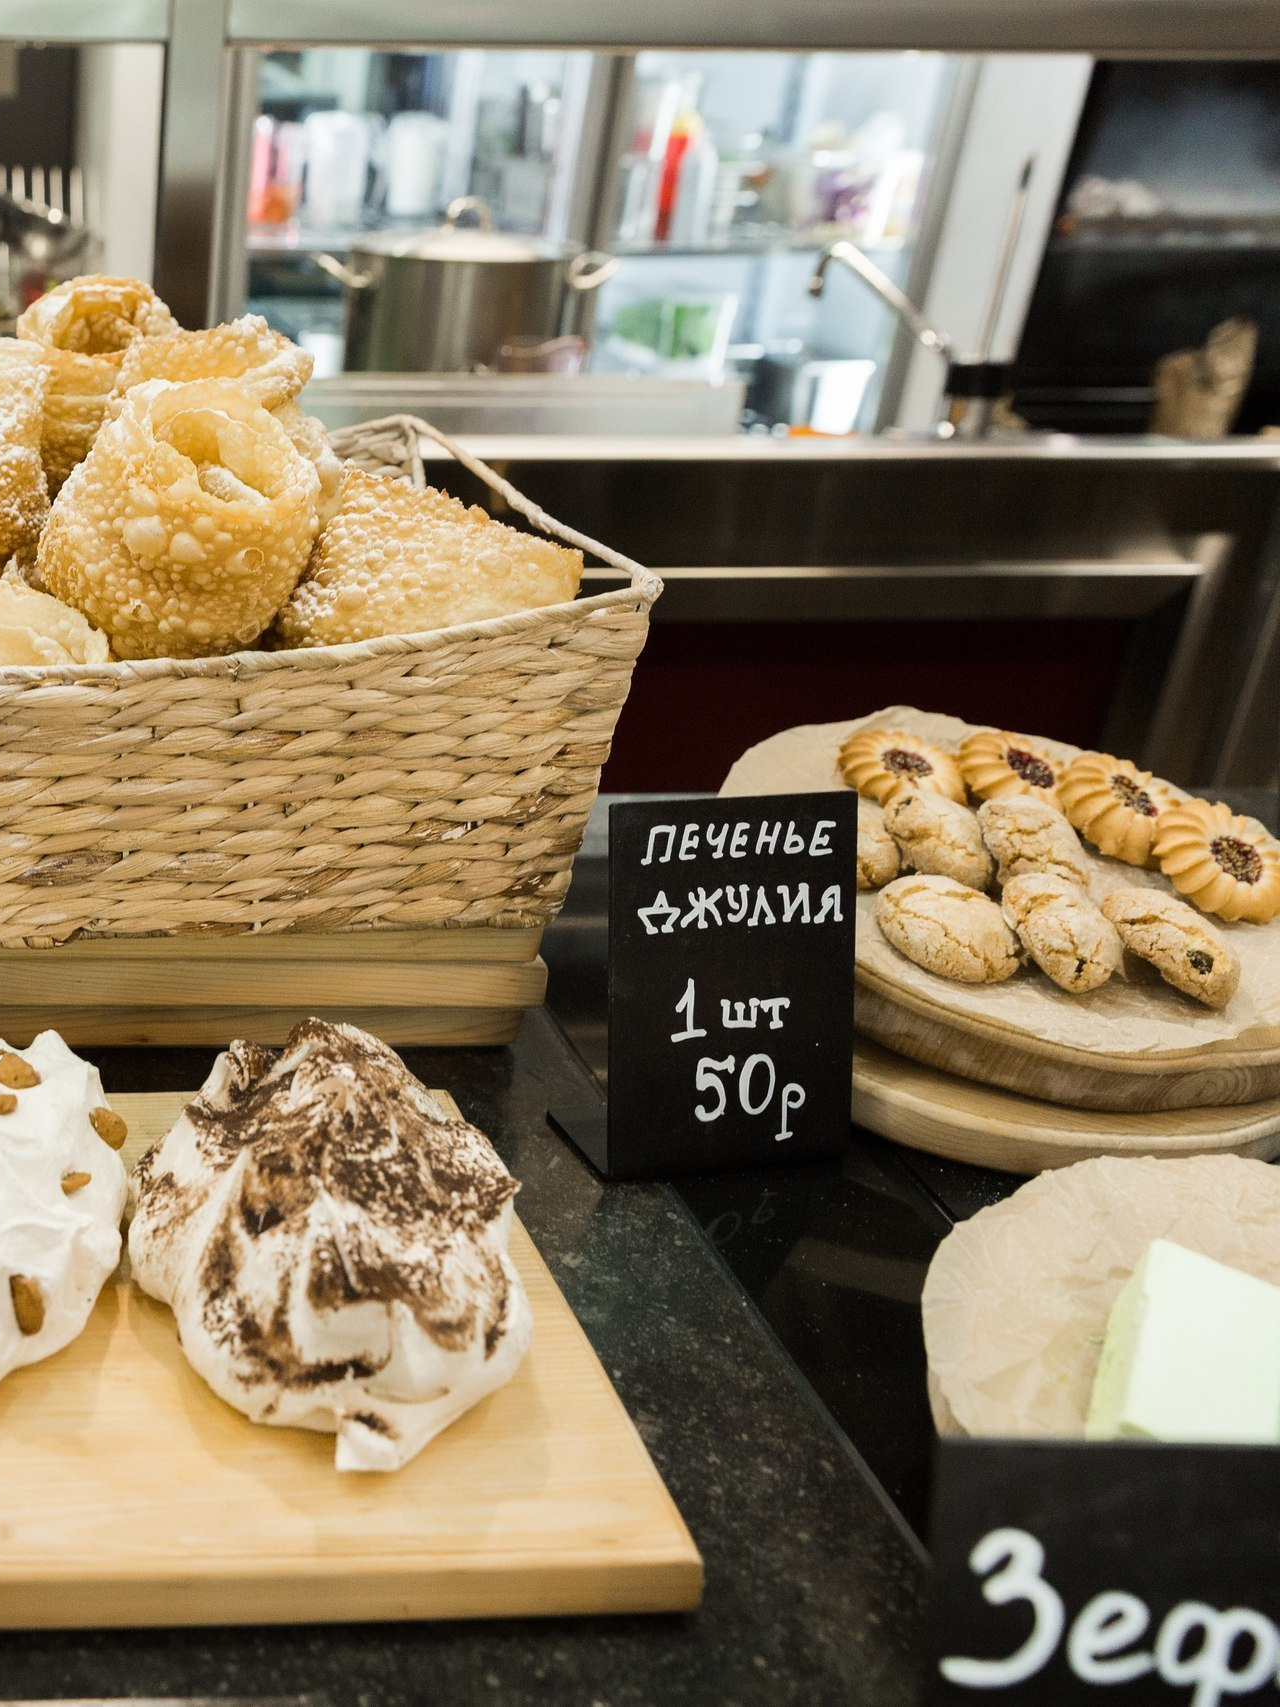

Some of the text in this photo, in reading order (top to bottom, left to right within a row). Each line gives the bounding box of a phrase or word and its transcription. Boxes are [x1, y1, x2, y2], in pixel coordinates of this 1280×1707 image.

[640, 820, 837, 866] ПЕЧЕНЬЕ
[637, 883, 845, 935] ДЖУЛИЯ
[670, 977, 708, 1043] 1
[939, 1527, 1280, 1707] Зеф
